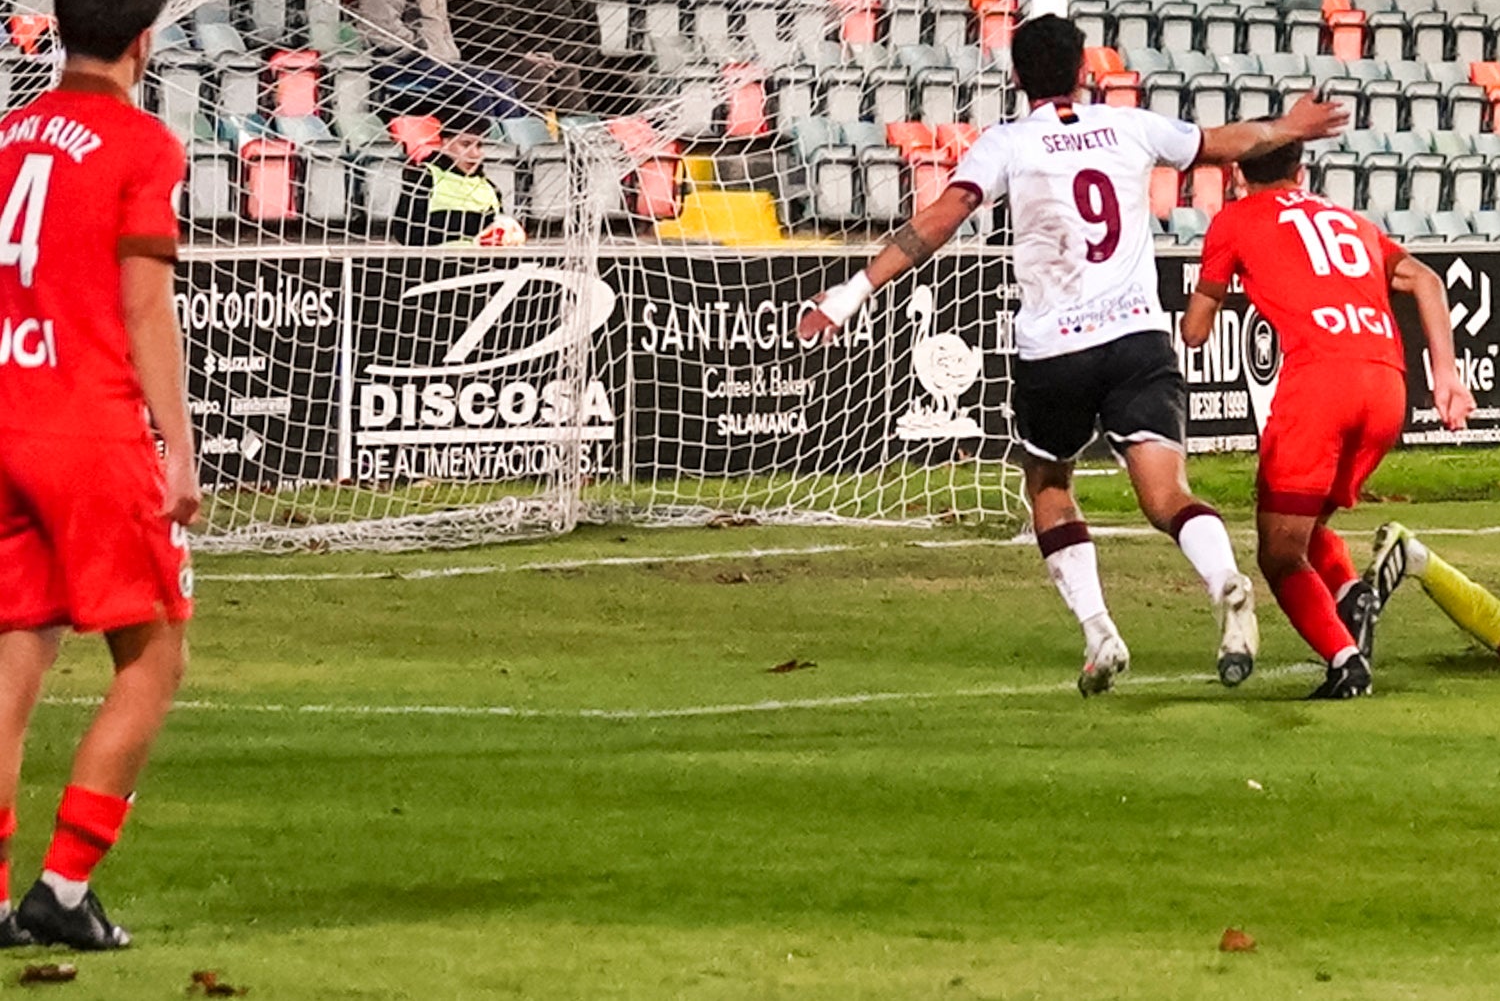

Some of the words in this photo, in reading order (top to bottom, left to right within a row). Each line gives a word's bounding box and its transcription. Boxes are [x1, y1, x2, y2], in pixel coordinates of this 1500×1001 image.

[40, 115, 103, 163] RUIZ
[1042, 127, 1119, 153] SERVETTI
[0, 153, 54, 288] 4
[1073, 168, 1121, 264] 9
[1277, 208, 1371, 278] 16
[641, 300, 874, 352] SANTAGLOIA
[1311, 302, 1394, 339] DIGI
[359, 381, 615, 428] DISCOSA
[751, 364, 768, 397] &
[770, 363, 816, 403] Bakery
[717, 411, 809, 436] SALAMANCA
[1189, 391, 1223, 420] DESDE
[357, 448, 391, 480] DE
